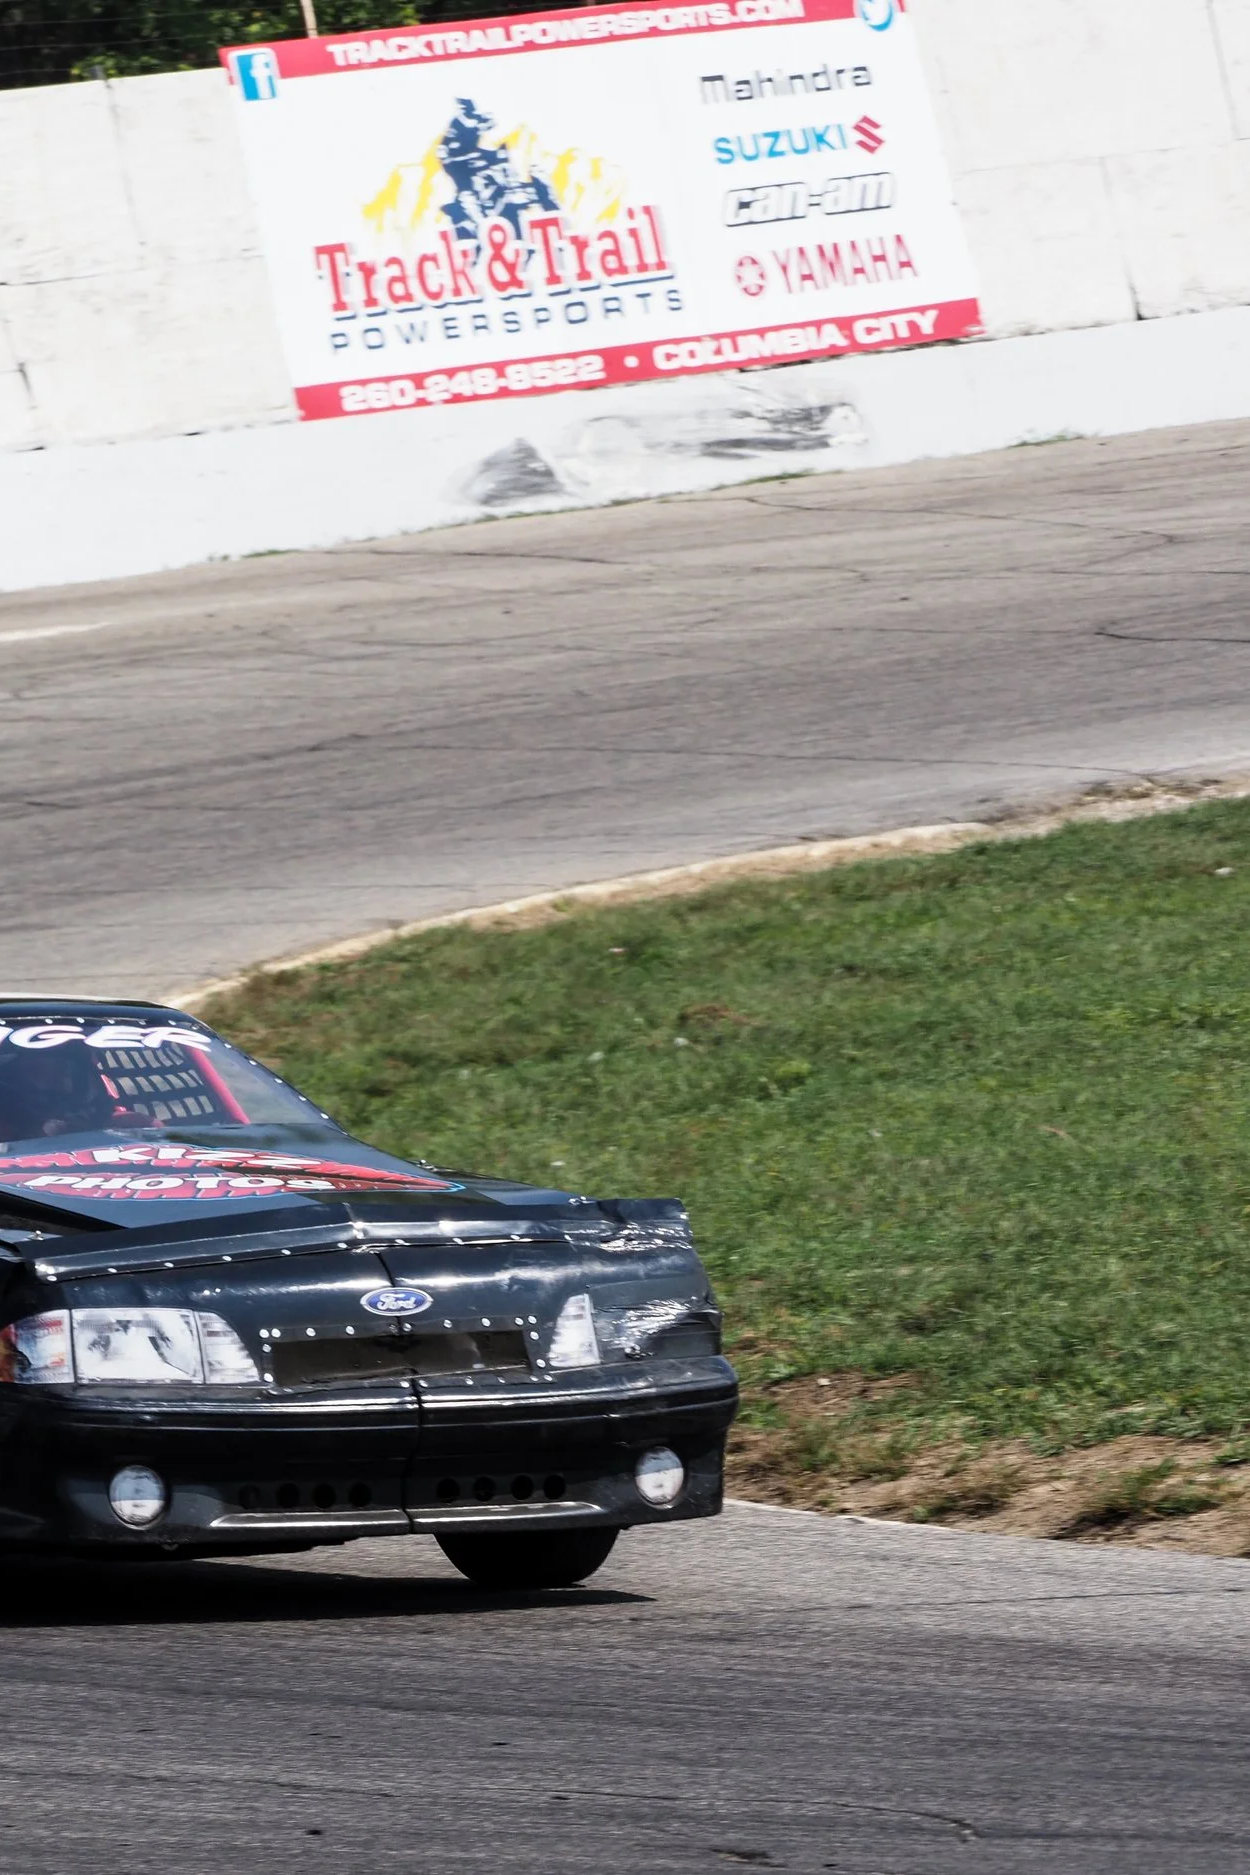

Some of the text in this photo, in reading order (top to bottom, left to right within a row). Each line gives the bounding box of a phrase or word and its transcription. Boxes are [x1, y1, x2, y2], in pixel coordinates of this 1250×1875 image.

[326, 0, 805, 67] TRACKTRAILPOWERSPORTS.COM
[699, 63, 872, 103] Mahindra
[713, 123, 848, 165] SUZUKI
[771, 234, 918, 295] YAMAHA
[328, 289, 685, 355] POWERSPORTS
[338, 310, 940, 411] 260-248-8522 COLUMBIA CITY
[91, 1147, 322, 1169] KIZZ
[24, 1175, 336, 1190] PHOTOS
[376, 1293, 417, 1310] Ford
